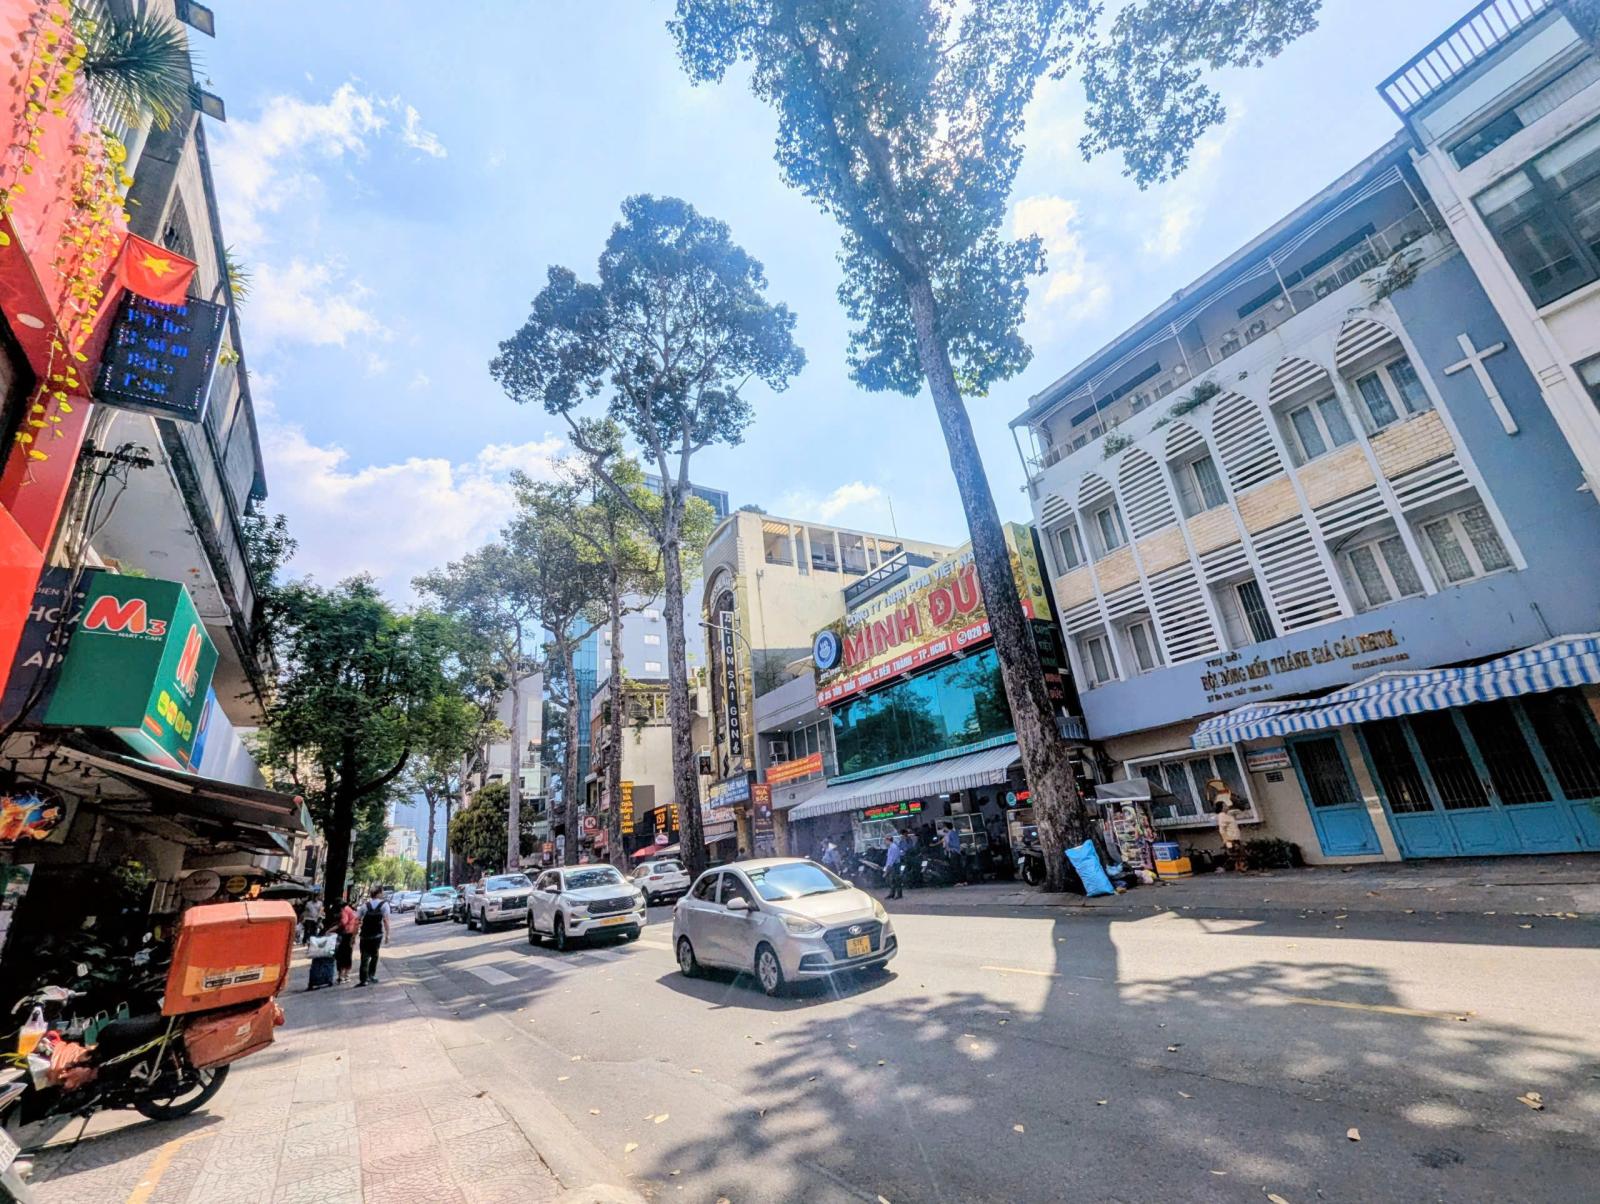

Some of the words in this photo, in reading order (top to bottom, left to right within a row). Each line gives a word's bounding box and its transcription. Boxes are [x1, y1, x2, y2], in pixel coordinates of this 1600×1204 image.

[842, 602, 923, 667] MINH
[928, 563, 981, 627] ĐỨ
[870, 601, 881, 615] TY
[884, 589, 906, 607] TNHH
[1271, 650, 1312, 674] THÁNH
[726, 670, 737, 701] SAI
[729, 705, 741, 739] GON
